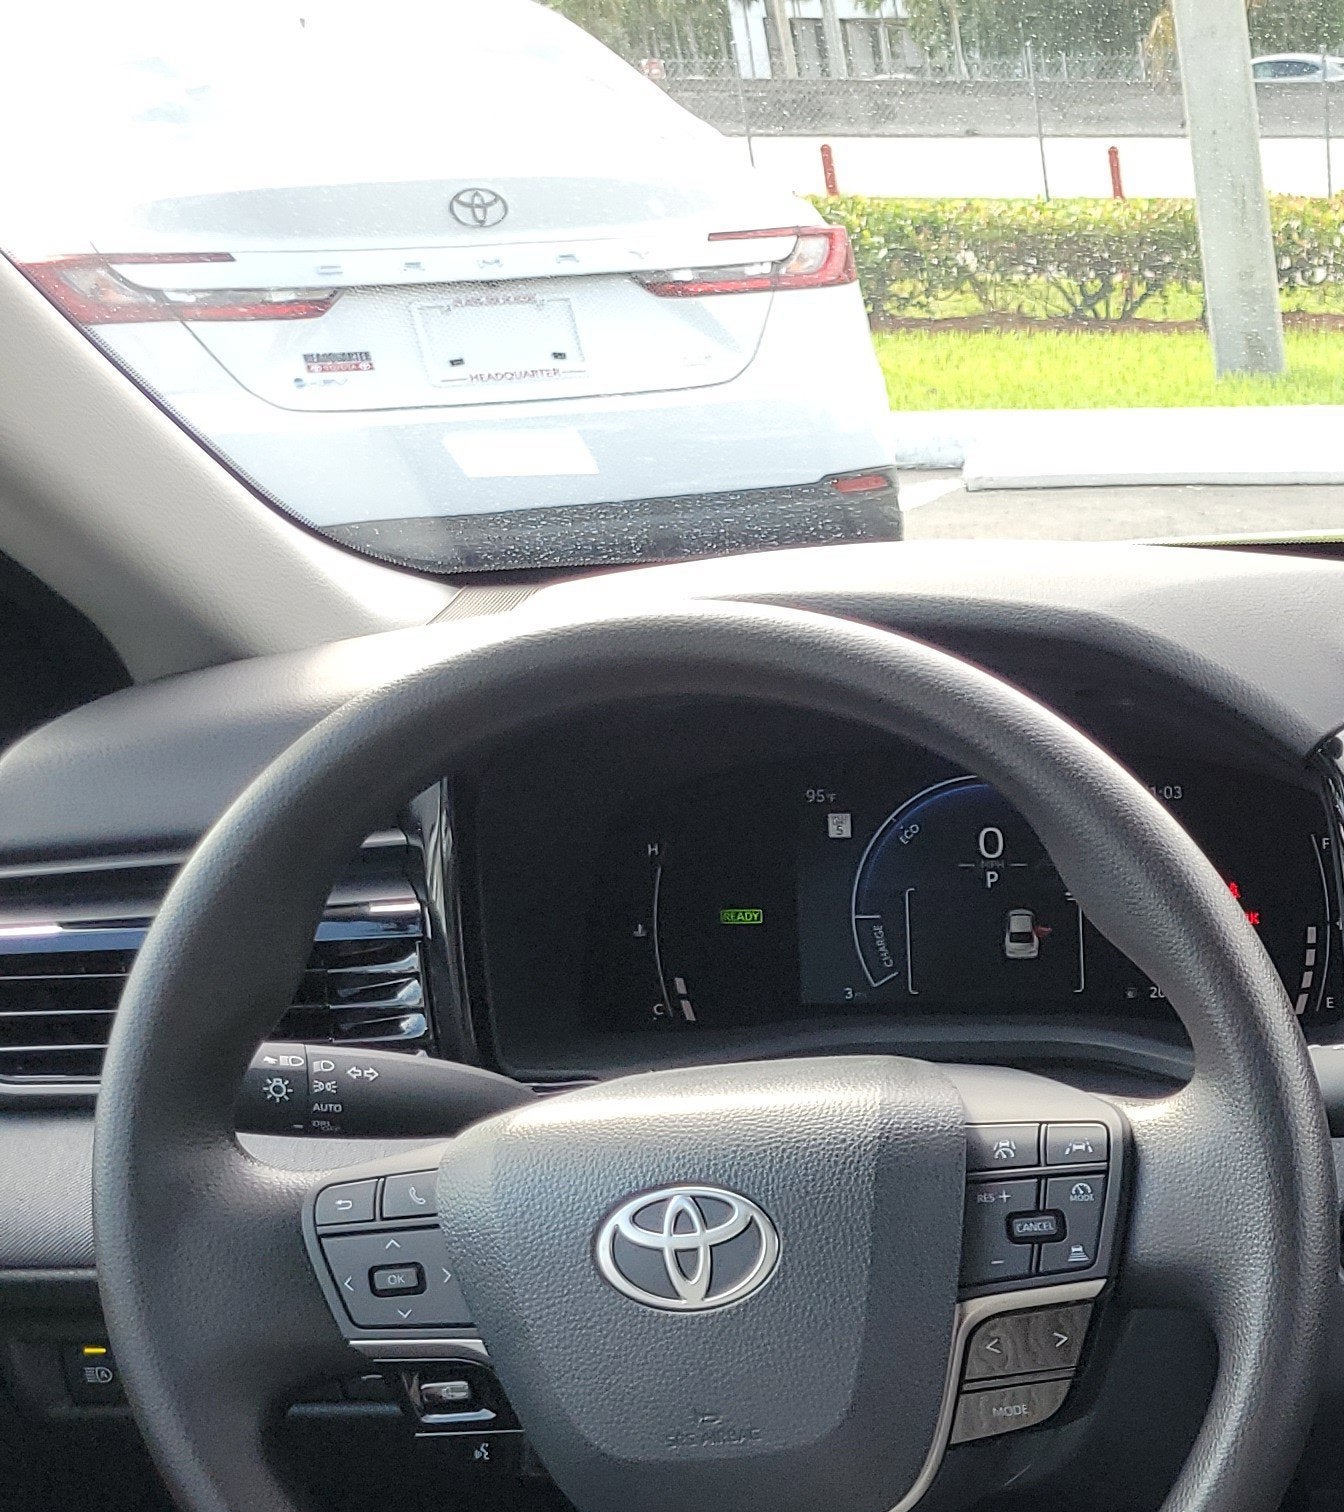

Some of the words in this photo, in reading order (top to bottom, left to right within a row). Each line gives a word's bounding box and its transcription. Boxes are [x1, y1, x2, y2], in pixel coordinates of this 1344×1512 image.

[469, 368, 560, 383] HEADQUARTER
[899, 824, 920, 845] ECO
[648, 843, 659, 855] H
[986, 871, 999, 888] P
[724, 910, 760, 921] READY
[873, 925, 894, 968] CHARGE
[844, 988, 853, 999] 3
[653, 1003, 664, 1015] C
[312, 1103, 342, 1113] AUTO
[977, 1193, 995, 1203] RES
[1016, 1220, 1055, 1233] CANCEL
[387, 1274, 405, 1286] OK
[992, 1404, 1029, 1418] MODE
